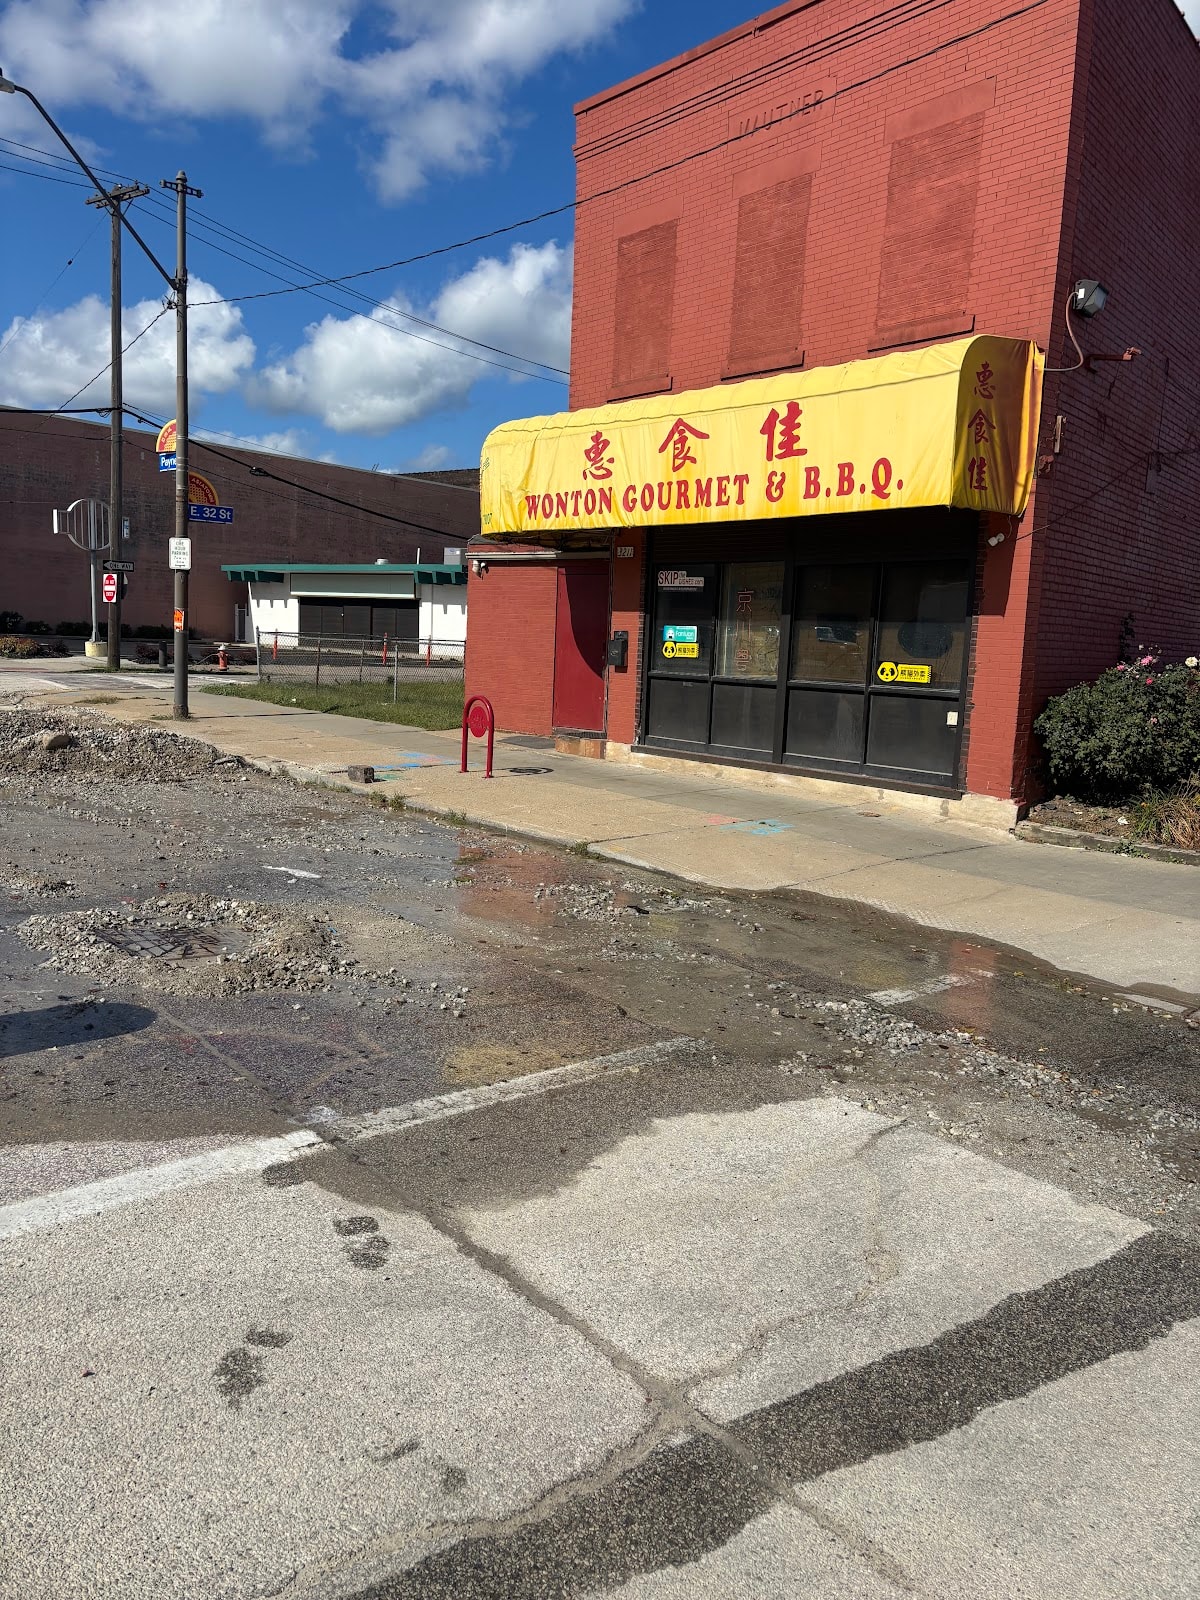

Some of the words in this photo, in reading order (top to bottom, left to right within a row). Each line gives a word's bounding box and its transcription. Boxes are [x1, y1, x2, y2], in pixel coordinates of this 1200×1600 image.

[525, 487, 613, 519] WONTON
[622, 474, 749, 513] GOURMET
[765, 472, 786, 502] &
[803, 457, 903, 500] B.B.Q.
[190, 505, 200, 517] E.
[203, 507, 217, 519] 32
[219, 509, 232, 520] St
[658, 571, 678, 585] SKIP
